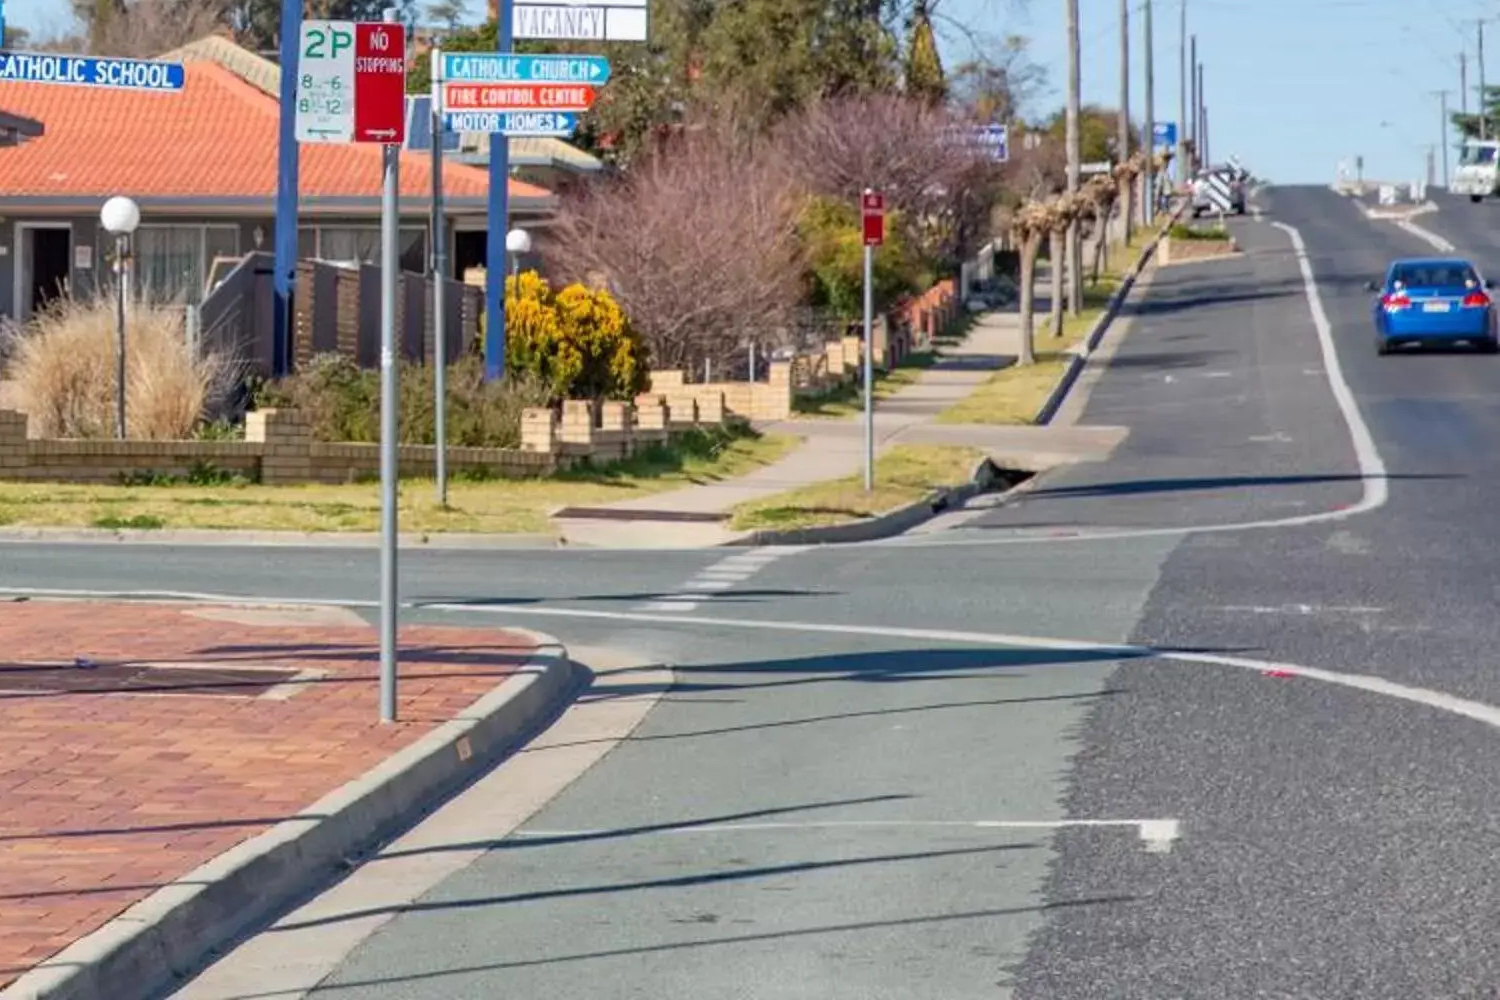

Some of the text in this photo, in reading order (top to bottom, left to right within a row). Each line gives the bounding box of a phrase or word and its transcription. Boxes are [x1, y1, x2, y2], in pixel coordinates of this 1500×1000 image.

[517, 7, 601, 37] VACANCY
[304, 29, 352, 59] 2P
[369, 31, 390, 51] NO
[94, 61, 174, 88] SCHOOL
[356, 56, 404, 74] STOPPING
[451, 57, 590, 80] CATHOLIC CHURCH
[450, 87, 587, 105] FIRE CONTROL CENTRE
[451, 112, 555, 131] MOTOR HOMES
